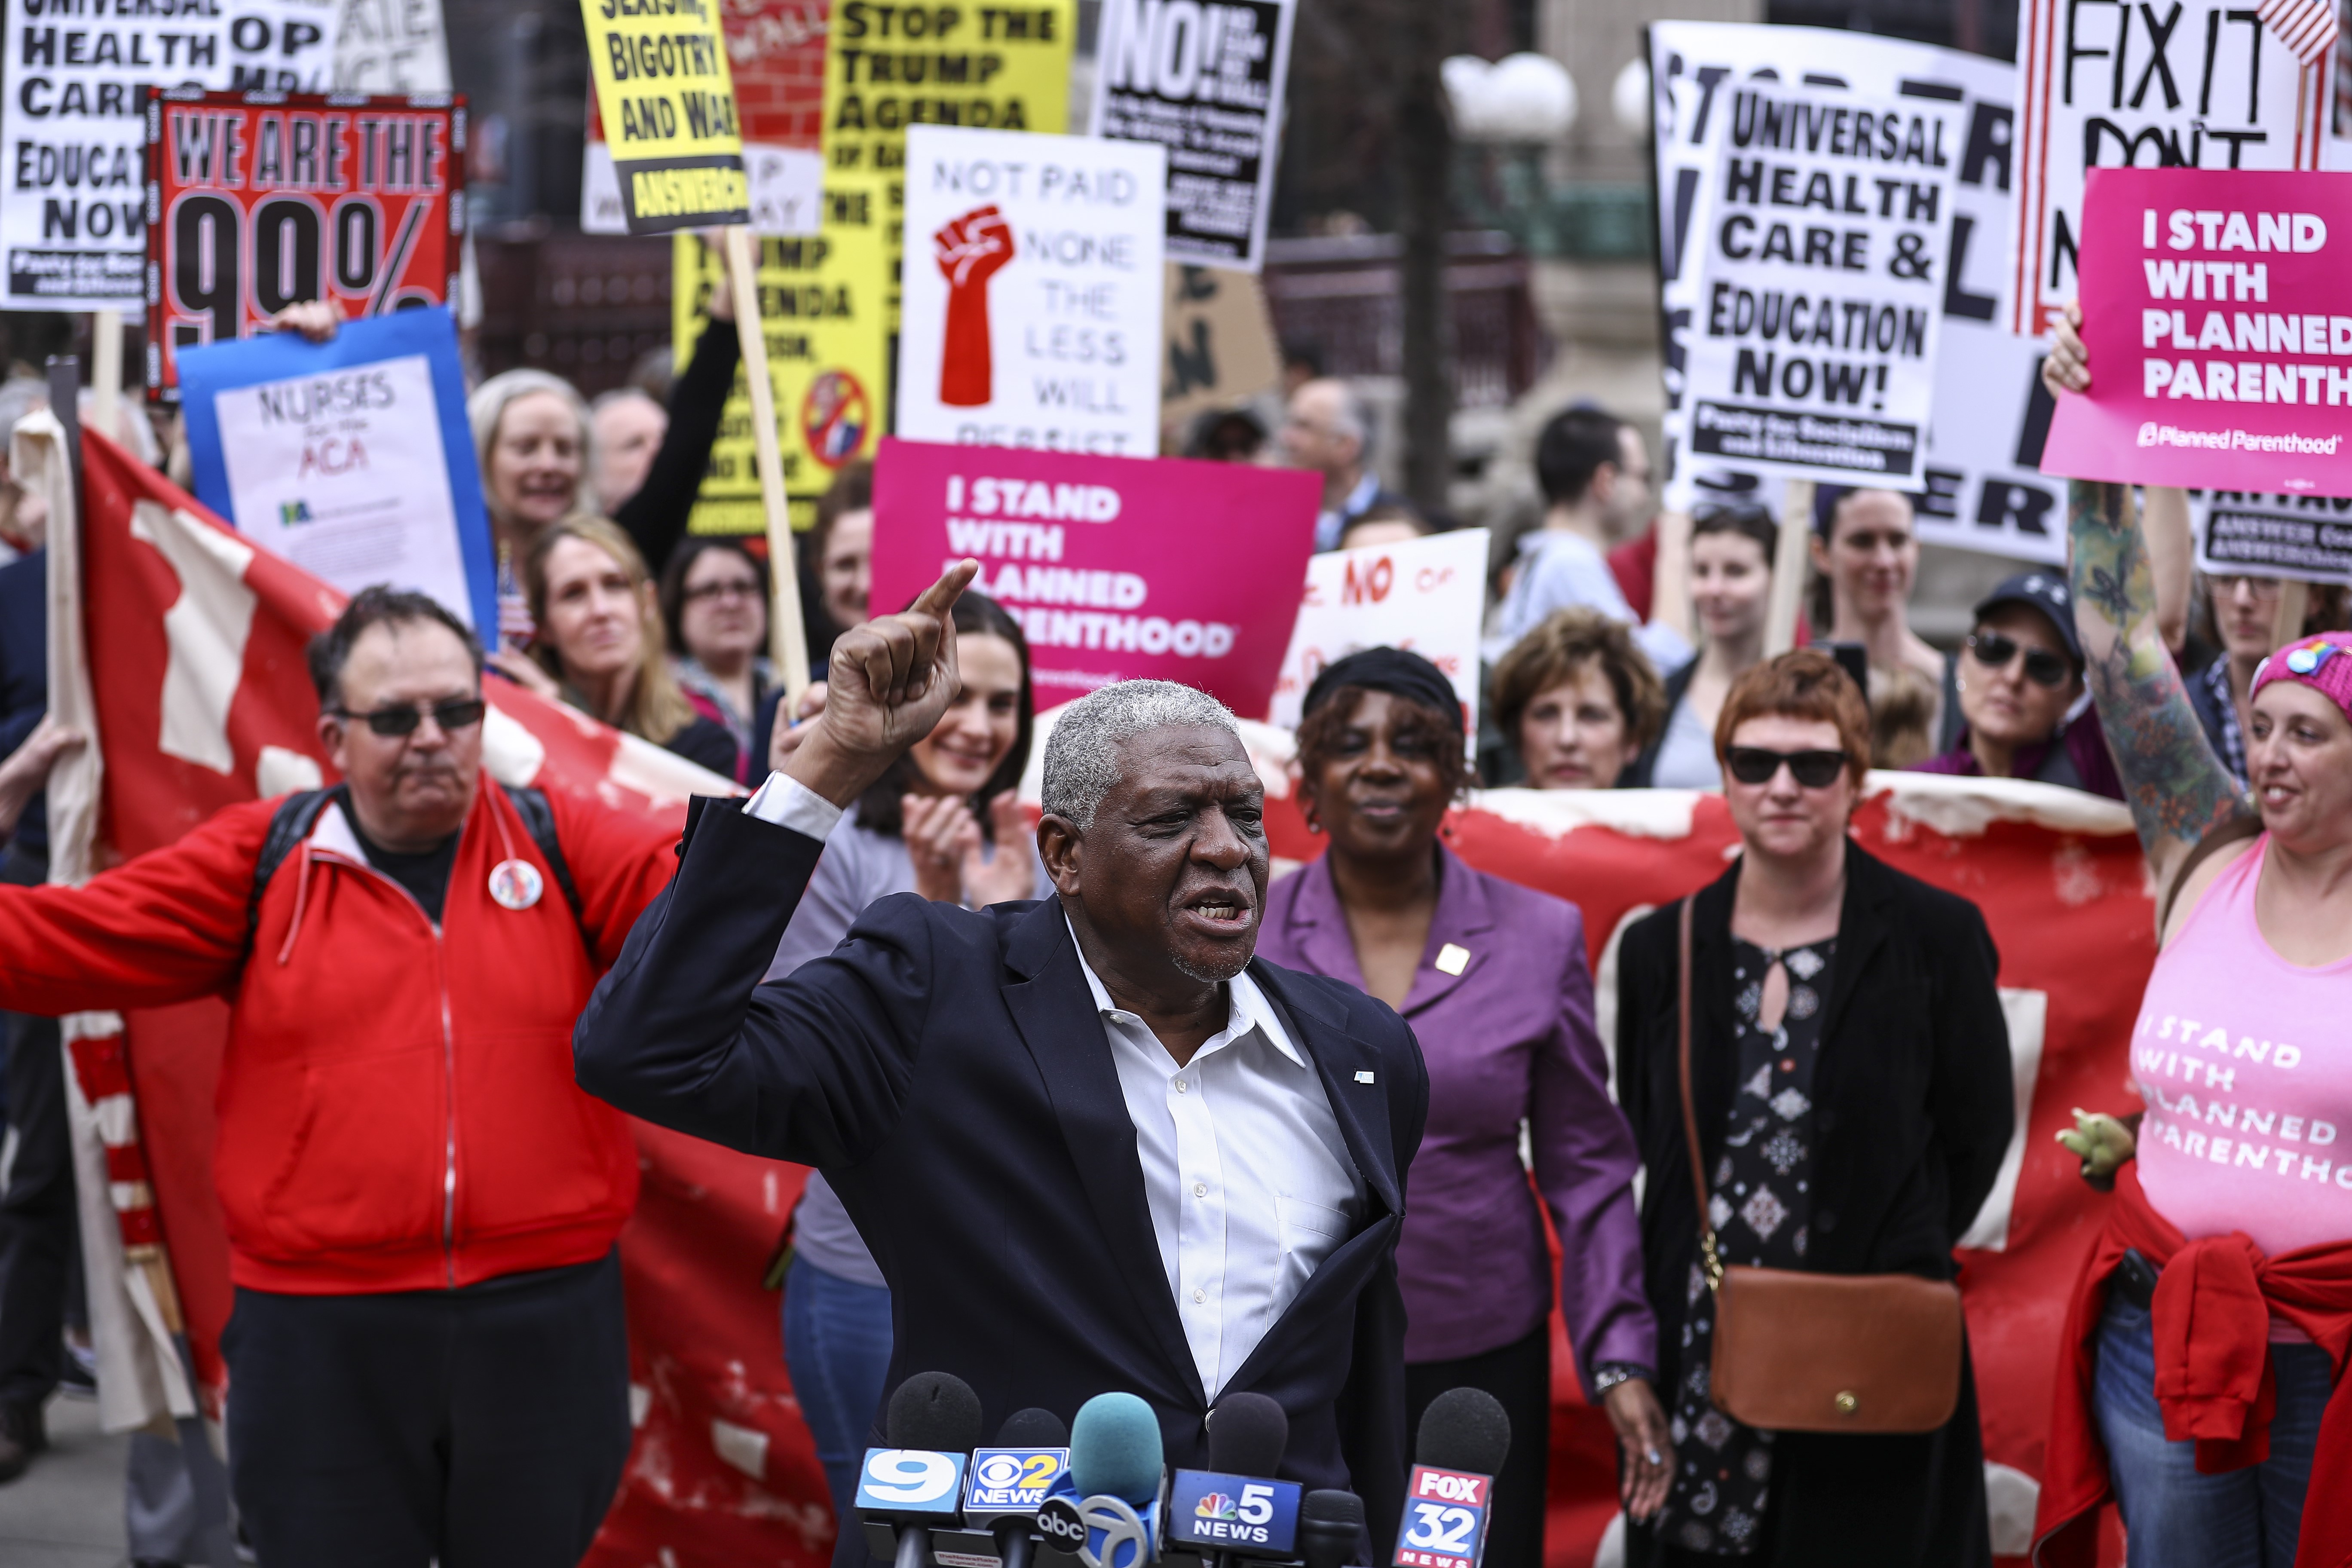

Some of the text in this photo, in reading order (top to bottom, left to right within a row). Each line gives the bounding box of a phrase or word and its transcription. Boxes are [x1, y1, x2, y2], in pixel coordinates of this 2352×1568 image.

[842, 3, 1057, 41] STOP THE
[23, 28, 216, 67] HEALTH
[606, 33, 719, 81] BIGOTRY
[841, 48, 1004, 85] TRUMP
[1109, 0, 1221, 101] NO!
[2064, 0, 2263, 124] FIX IT
[622, 96, 676, 142] AND
[836, 94, 1026, 129] AGENDA
[1732, 89, 1948, 170] UNIVERSAL
[15, 140, 146, 192] EDUCA
[167, 107, 446, 195] WE ARE THE
[934, 161, 1140, 206] NOT PAID
[1726, 157, 1940, 224] HEALTH
[1025, 230, 1136, 271] NONE
[1720, 213, 1872, 274] CARE
[1888, 231, 1936, 283] &
[2142, 208, 2328, 254] I STAND
[1040, 279, 1118, 320] THE
[2143, 259, 2269, 303] WITH
[1707, 282, 1929, 359] EDUCATION
[2142, 308, 2352, 356] PLANNED
[1026, 324, 1128, 368] LESS
[259, 371, 396, 427] NURSES
[1036, 377, 1128, 414] WILL
[1733, 347, 1890, 410] NOW!
[2143, 358, 2352, 407] PARENTH
[297, 438, 370, 479] ACA
[2158, 425, 2338, 456] Planned Parenthood
[946, 475, 1121, 524] I STAND
[946, 518, 1064, 561] WITH
[1342, 554, 1393, 607] NO
[1006, 605, 1236, 658] ENTHOOD
[2156, 1014, 2302, 1070] STAND
[2138, 1047, 2236, 1092] WITH
[863, 1449, 957, 1504] 9
[1018, 1455, 1059, 1489] 2
[1419, 1474, 1482, 1503] FOX
[973, 1488, 1046, 1504] NEWS
[1238, 1483, 1275, 1525] 5
[1037, 1511, 1084, 1541] abc
[1193, 1519, 1269, 1543] NEWS
[1406, 1503, 1477, 1553] 32
[1401, 1551, 1468, 1568] NEWS
